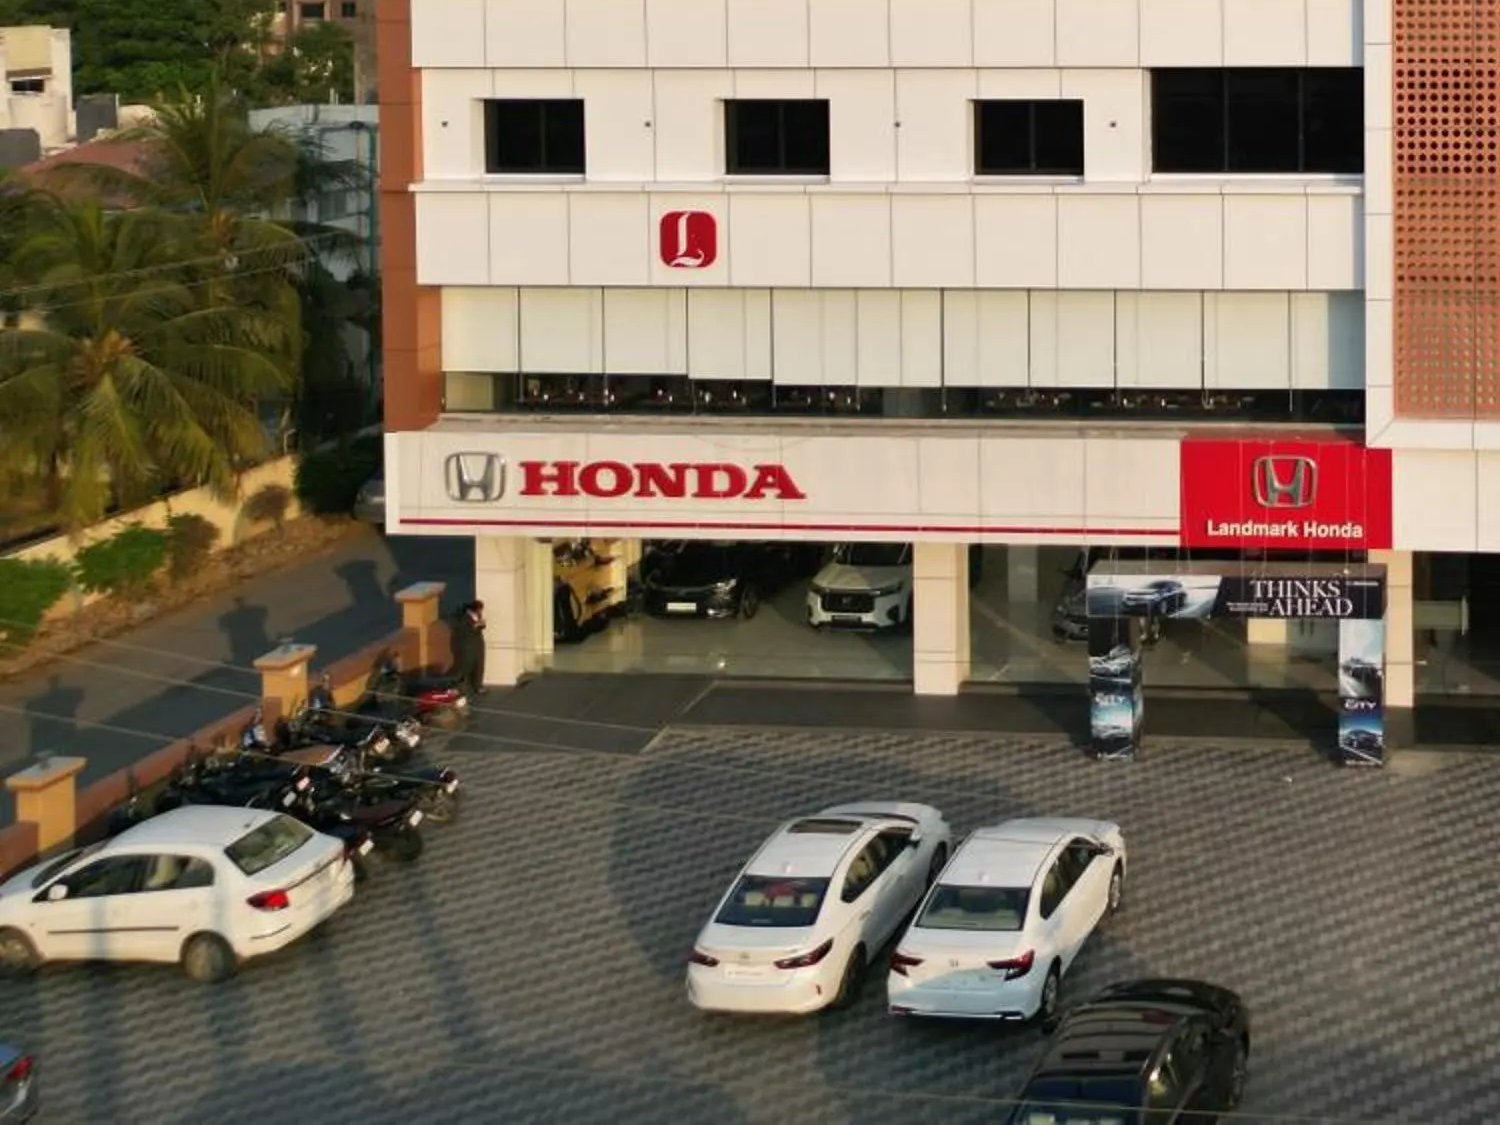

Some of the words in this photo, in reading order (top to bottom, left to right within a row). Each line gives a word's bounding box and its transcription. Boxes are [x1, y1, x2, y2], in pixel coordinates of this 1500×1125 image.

[519, 460, 807, 500] HONDA
[1207, 518, 1298, 538] Landmark
[1303, 520, 1364, 540] Honda
[1250, 578, 1342, 599] THINKS
[1269, 597, 1354, 617] AHEAD
